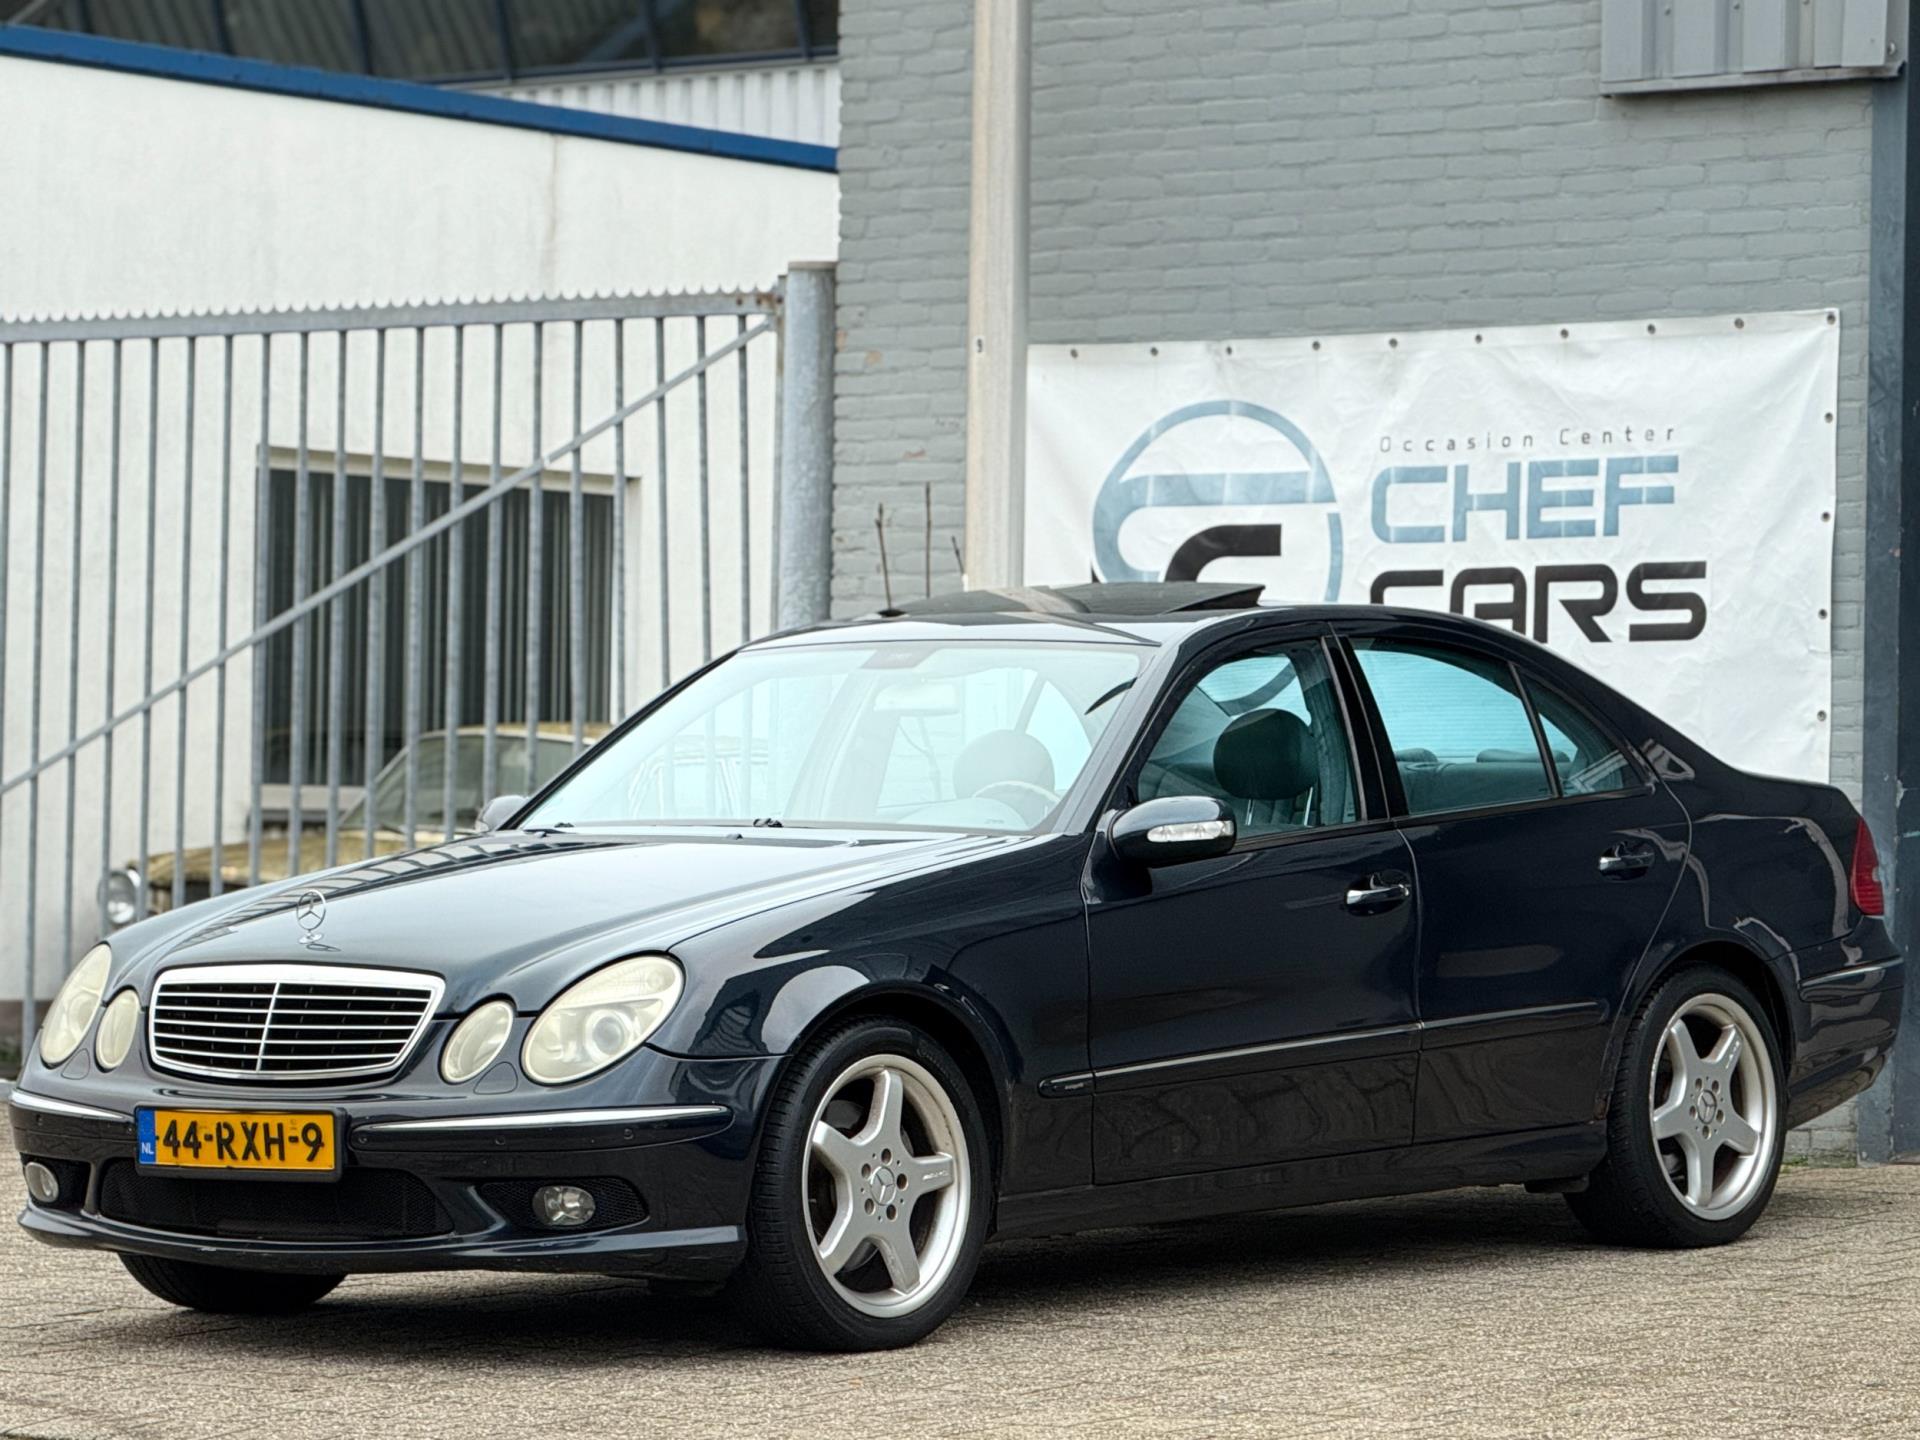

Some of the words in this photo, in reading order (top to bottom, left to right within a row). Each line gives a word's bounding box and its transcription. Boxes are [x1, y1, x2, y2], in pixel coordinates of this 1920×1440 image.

[1380, 432, 1534, 453] Occasion
[1559, 426, 1675, 446] Center
[1371, 455, 1679, 543] CHEF
[141, 1141, 155, 1155] NL
[162, 1119, 325, 1162] 44-RXH-9
